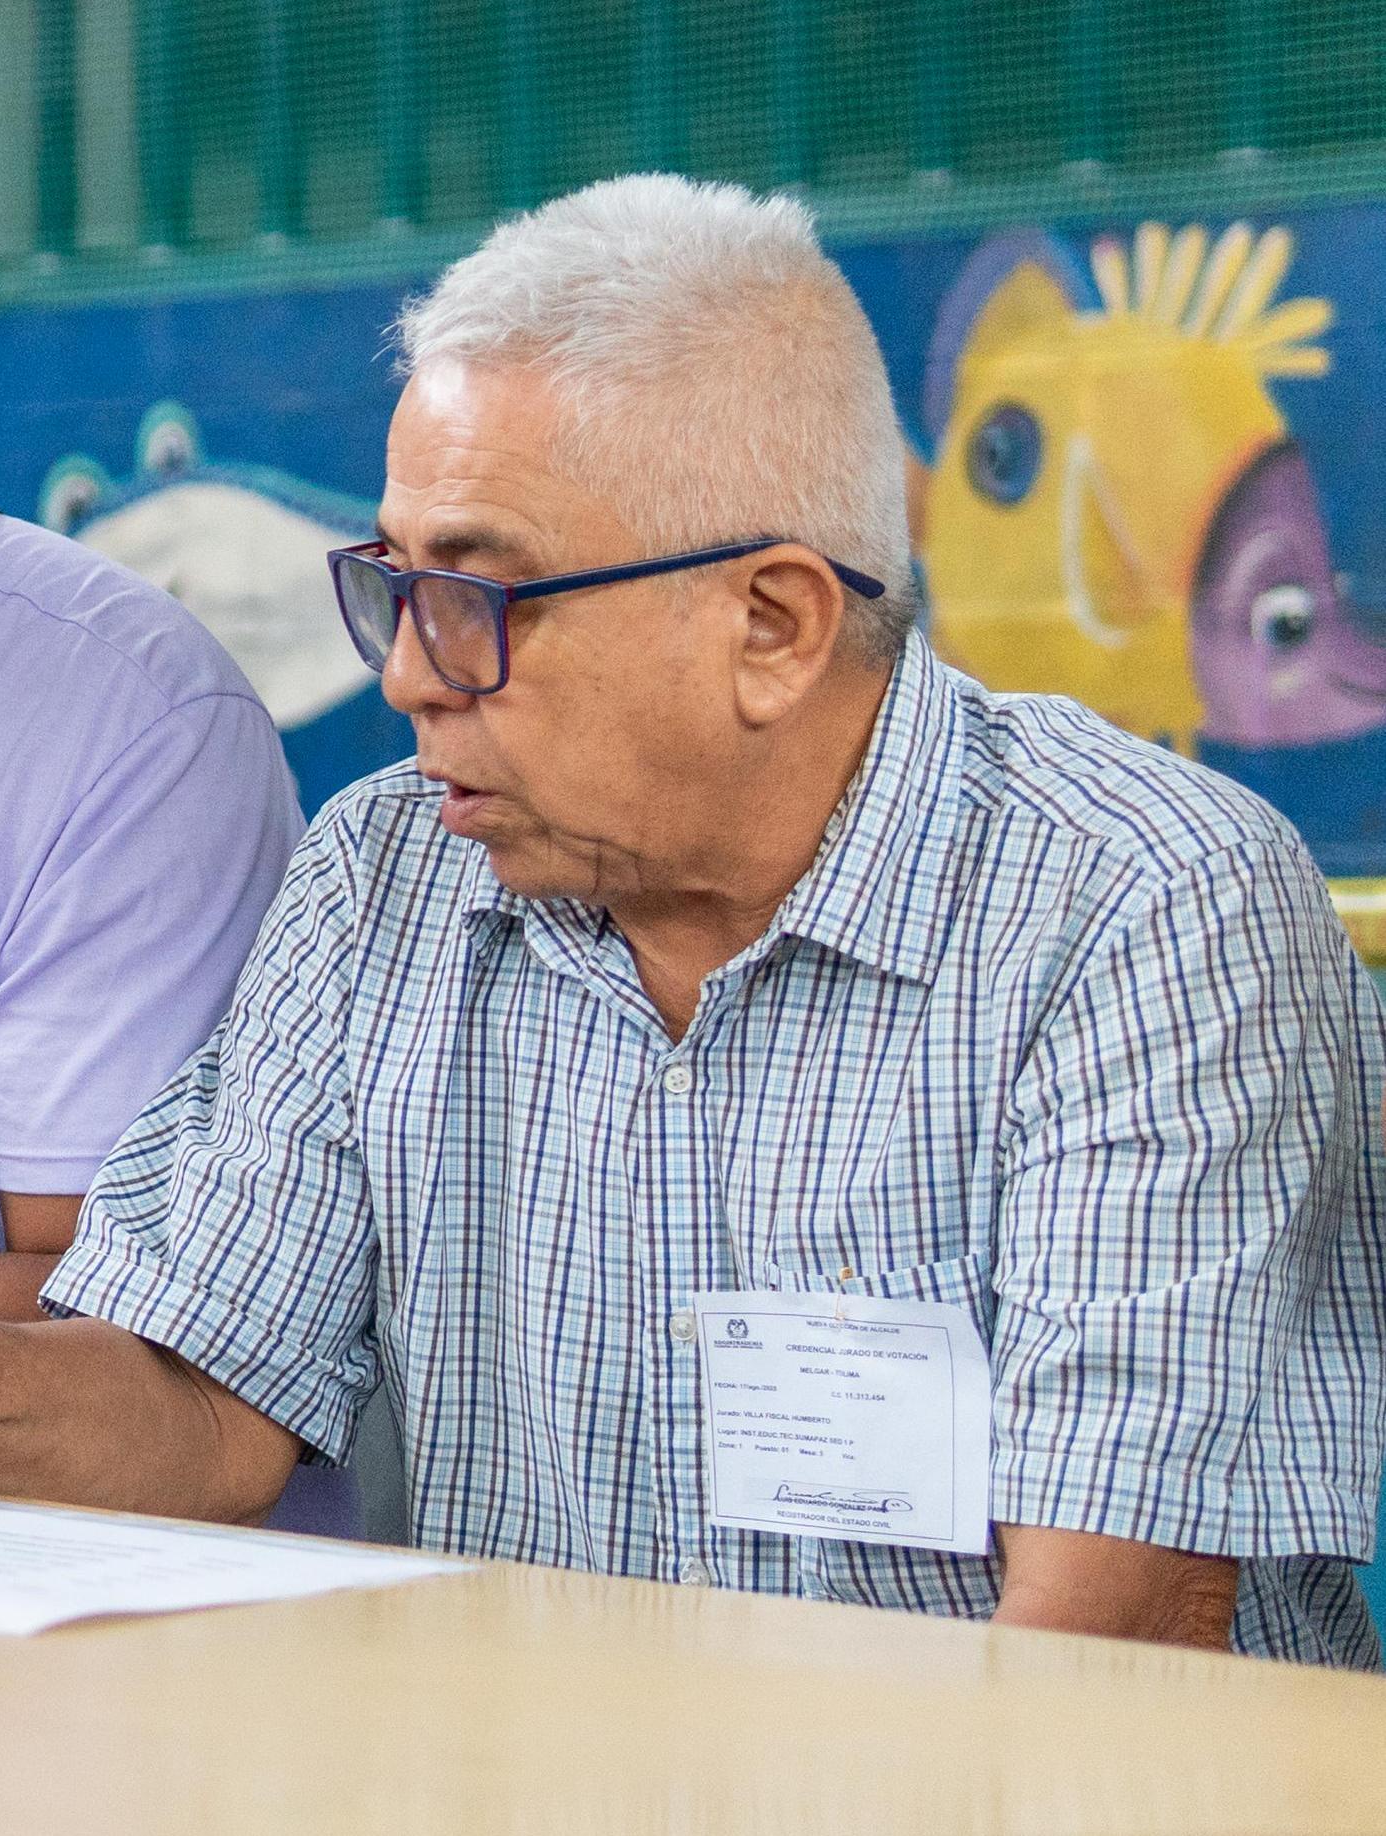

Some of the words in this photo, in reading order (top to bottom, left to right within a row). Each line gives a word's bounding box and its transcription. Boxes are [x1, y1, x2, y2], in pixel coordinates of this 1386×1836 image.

[785, 1344, 836, 1355] CREDENCIAL
[743, 1410, 764, 1419] VILLA
[841, 1516, 870, 1527] ESTADO
